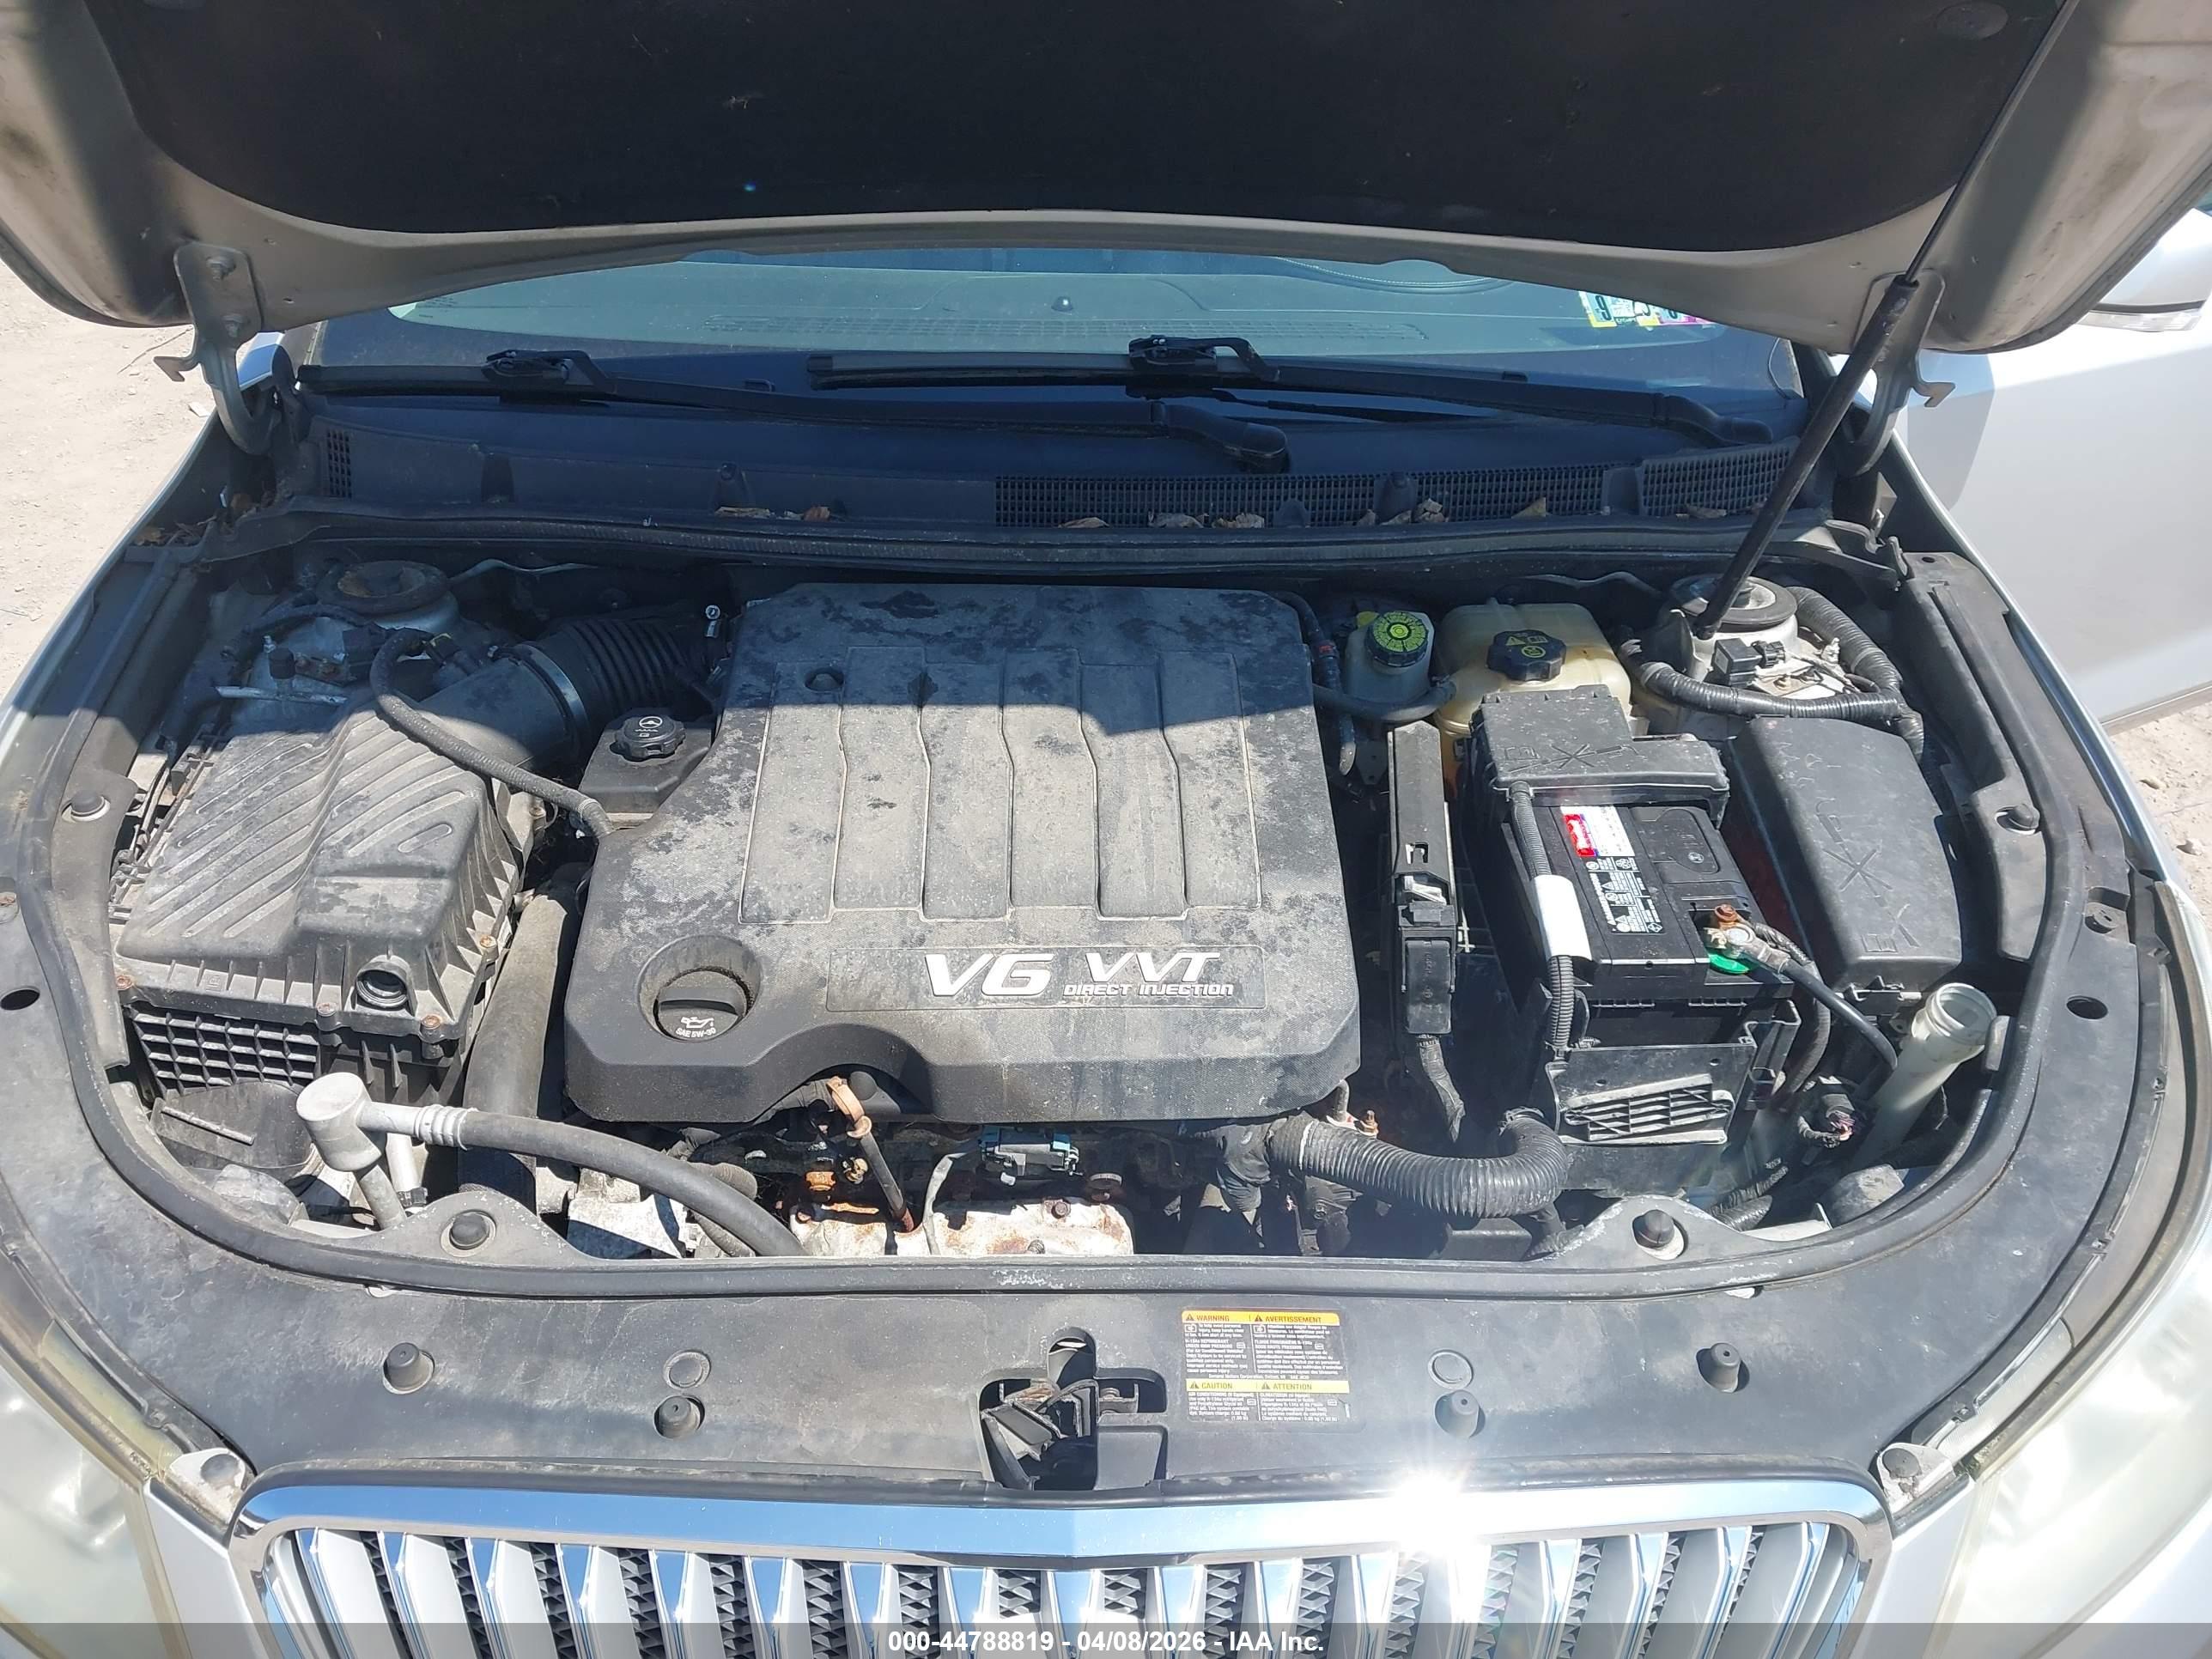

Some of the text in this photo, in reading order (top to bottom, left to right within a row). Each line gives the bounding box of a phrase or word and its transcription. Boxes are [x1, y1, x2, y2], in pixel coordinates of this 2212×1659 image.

[924, 952, 1221, 997] V6 VVT
[1062, 983, 1234, 997] DIRECT INJECTION
[675, 1027, 692, 1038] SAE
